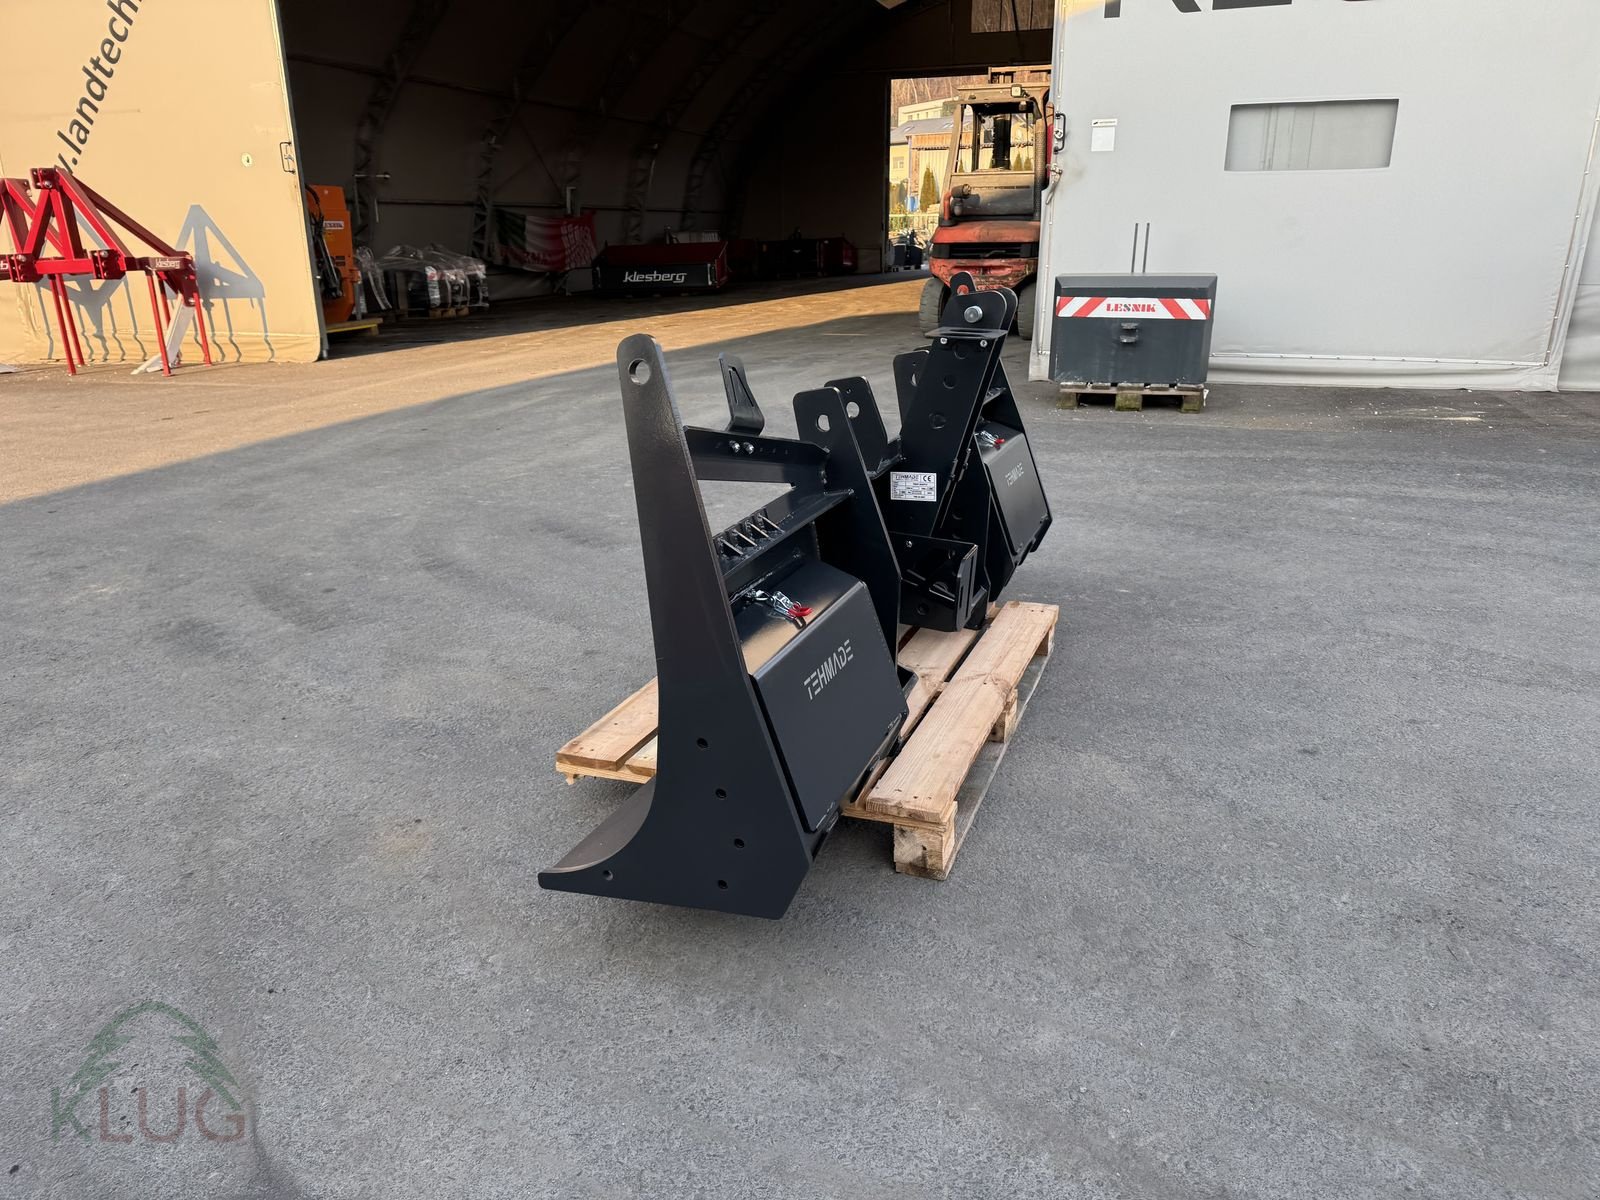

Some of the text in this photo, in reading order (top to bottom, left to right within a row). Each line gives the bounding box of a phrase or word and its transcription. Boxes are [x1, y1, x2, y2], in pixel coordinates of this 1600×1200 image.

[622, 270, 687, 283] klesberg
[1106, 303, 1157, 313] LESNIK
[803, 639, 854, 700] TEHMADE
